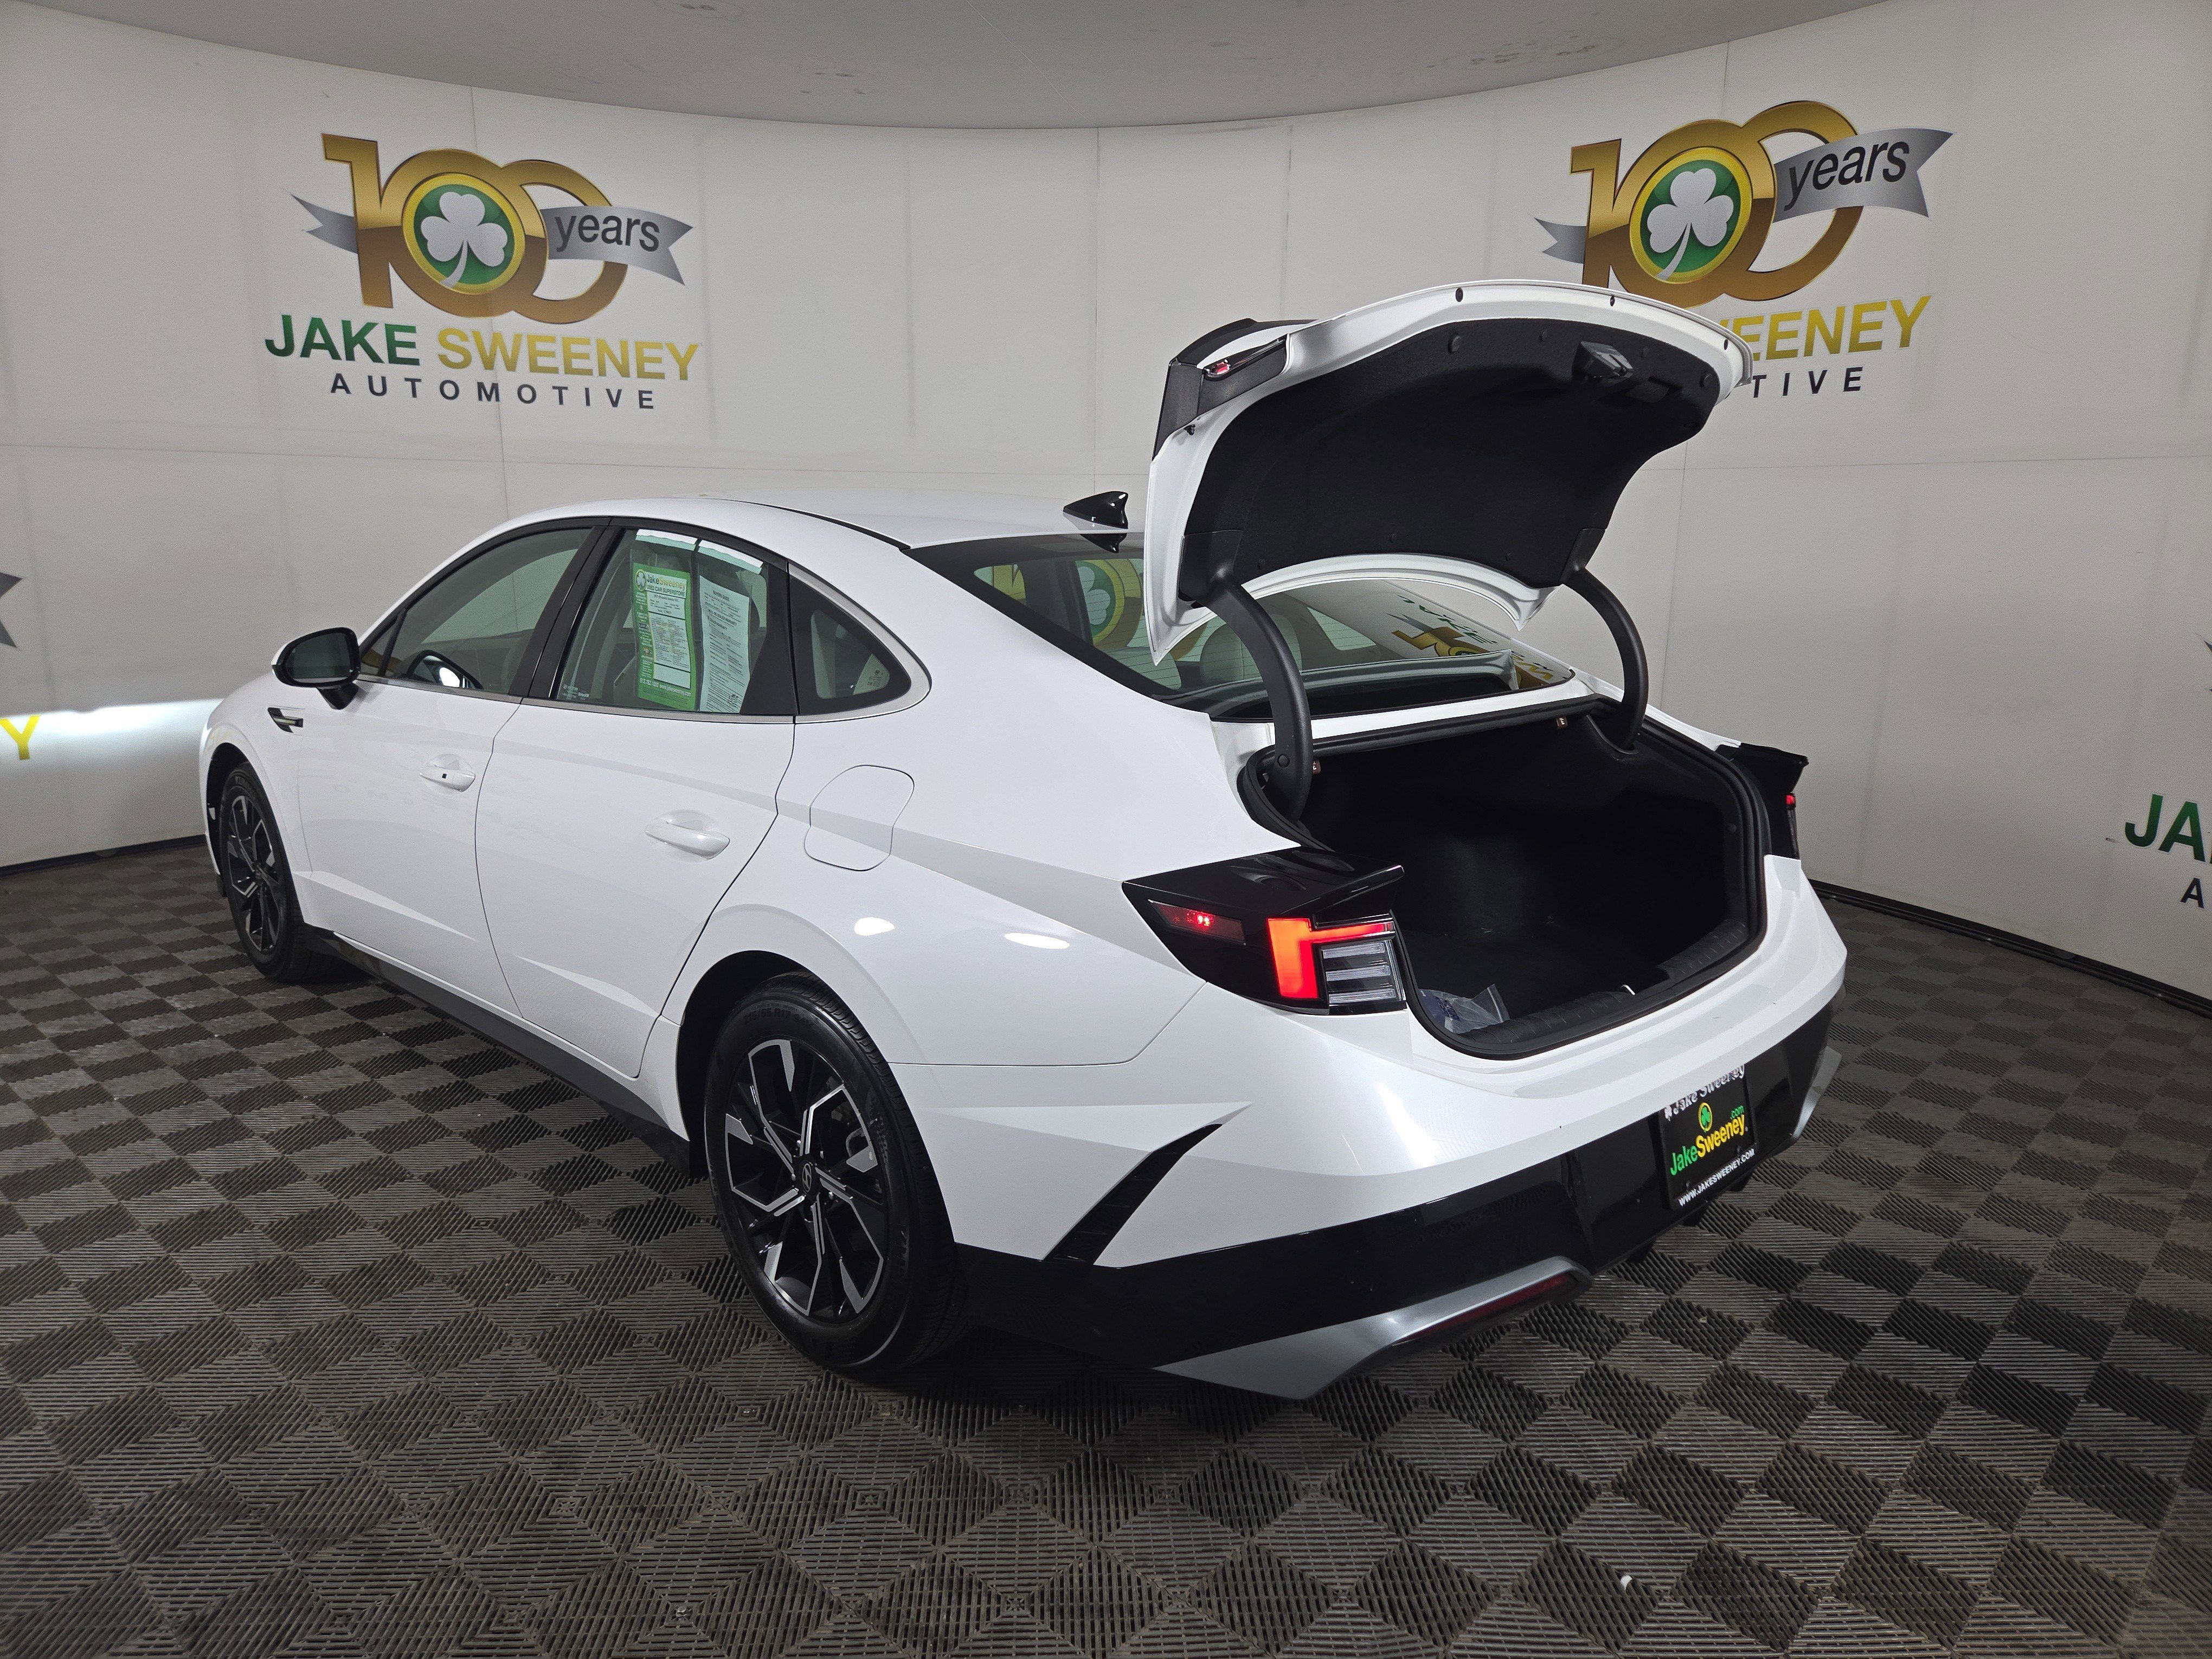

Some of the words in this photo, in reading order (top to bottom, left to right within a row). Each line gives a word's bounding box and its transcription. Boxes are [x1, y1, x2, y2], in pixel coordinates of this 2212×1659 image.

[1570, 100, 1864, 309] 100
[1784, 140, 1909, 211] years
[321, 133, 628, 324] 100
[555, 214, 660, 252] years
[264, 314, 421, 366] JAKE
[438, 327, 699, 381] SWEENEY
[1720, 295, 1932, 362] EENEY
[331, 372, 654, 409] AUTOMOTIVE
[2124, 794, 2212, 863] JA
[1678, 1148, 1755, 1207] WWW.JAKESWEENEY.COM
